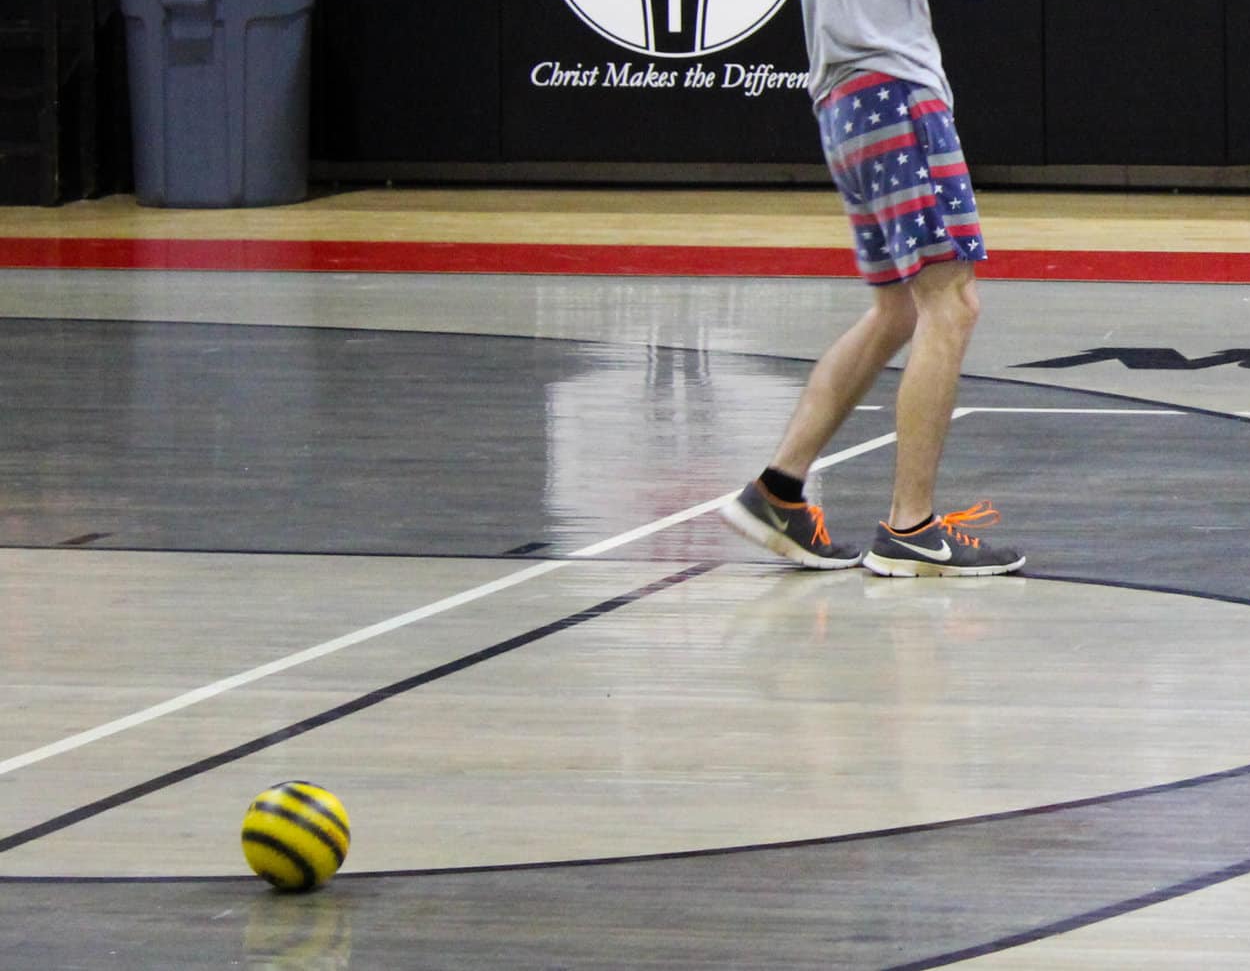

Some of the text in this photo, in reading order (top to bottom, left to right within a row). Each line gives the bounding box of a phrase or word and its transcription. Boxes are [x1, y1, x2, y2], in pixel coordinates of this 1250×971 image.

[530, 61, 599, 87] Christ
[602, 61, 676, 88] Makes
[684, 63, 714, 88] the
